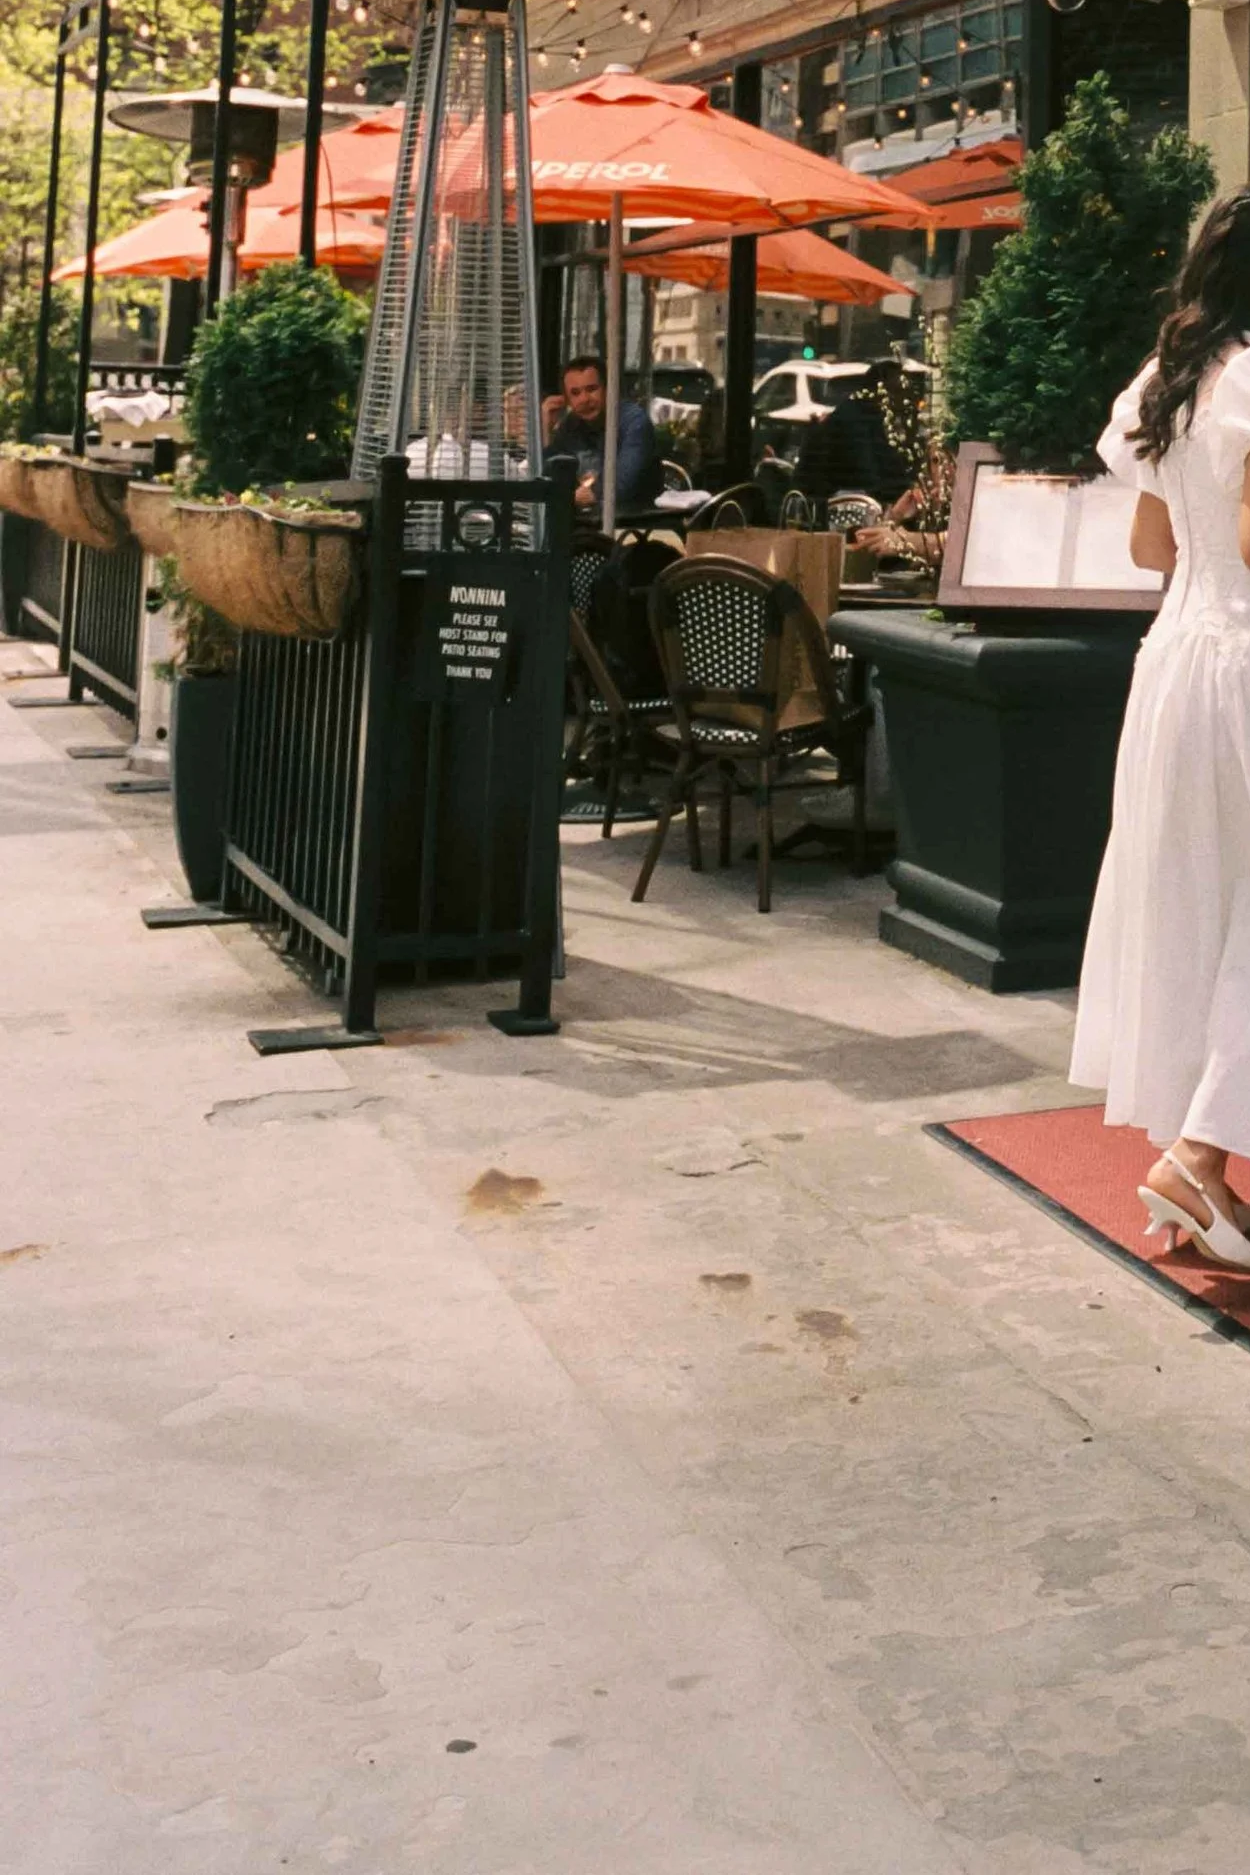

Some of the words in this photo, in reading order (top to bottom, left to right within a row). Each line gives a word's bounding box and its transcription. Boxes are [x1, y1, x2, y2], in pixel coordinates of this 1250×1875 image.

[450, 586, 506, 607] NONNINA
[453, 613, 481, 626] PLEASE
[483, 615, 498, 627] SEE
[439, 627, 461, 640] HOST
[462, 629, 489, 642] STAND
[491, 631, 508, 643] FOR
[441, 643, 466, 656] PATIO
[467, 645, 501, 659] SEATING
[446, 664, 473, 678] THANK
[475, 667, 493, 680] YOU
